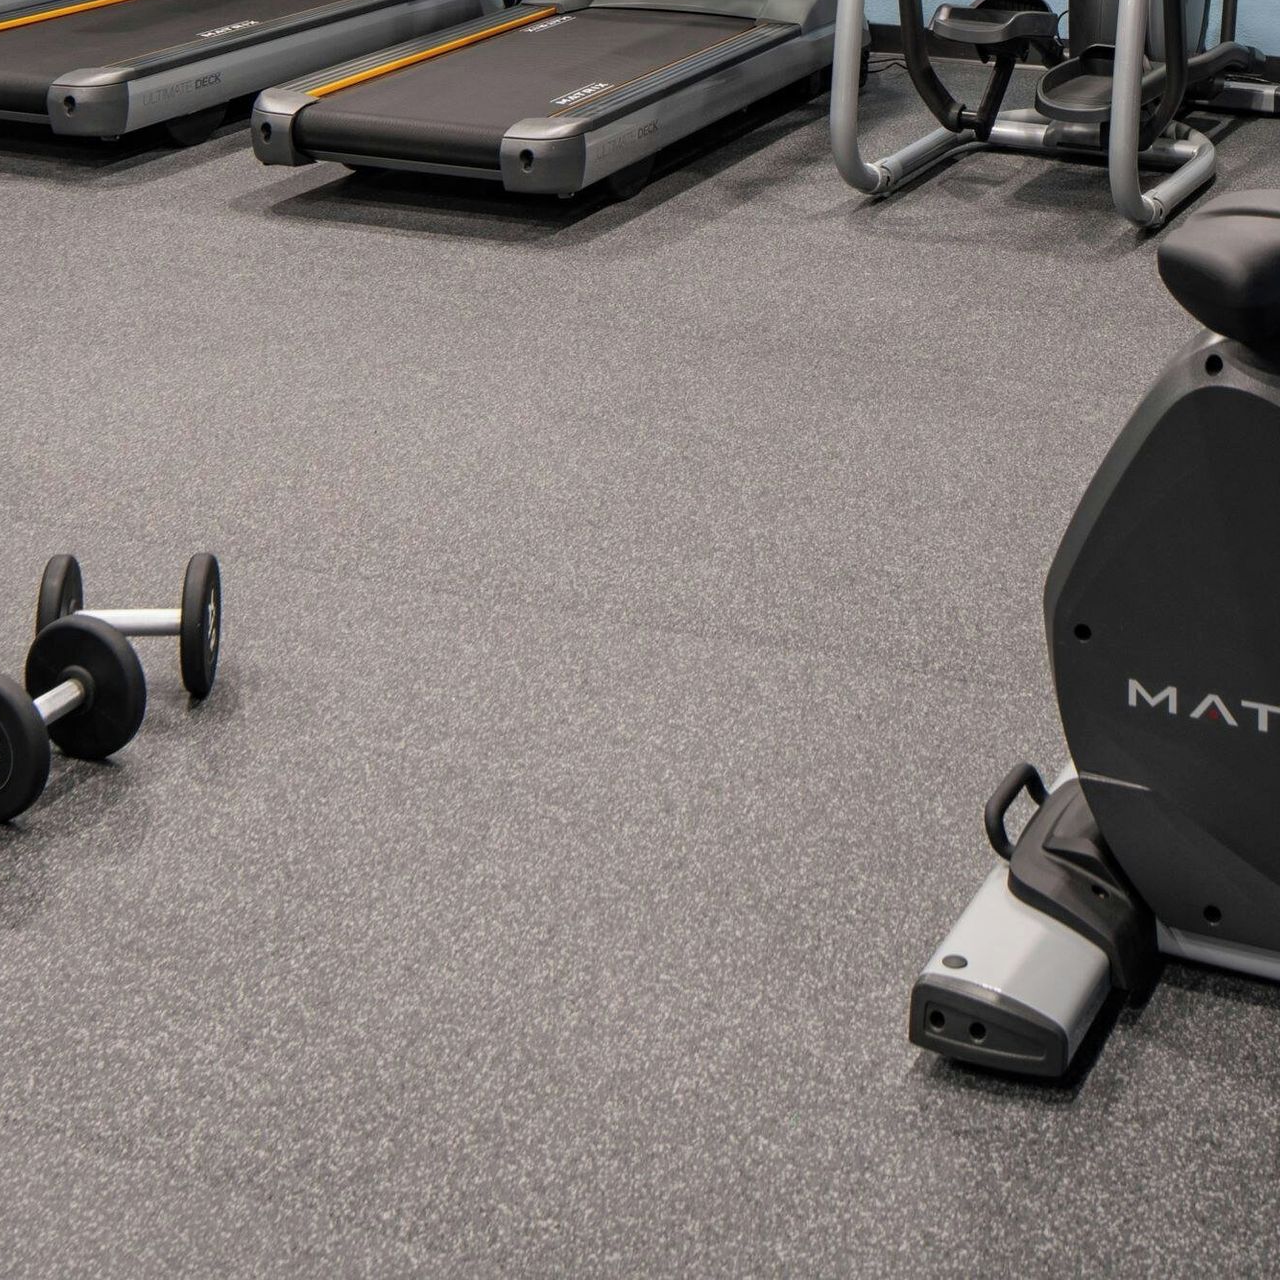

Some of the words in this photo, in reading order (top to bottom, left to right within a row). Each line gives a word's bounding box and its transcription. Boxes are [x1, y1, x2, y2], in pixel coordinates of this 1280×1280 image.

[195, 72, 223, 89] DECK
[555, 82, 608, 105] MATRIX
[637, 120, 660, 139] DECK
